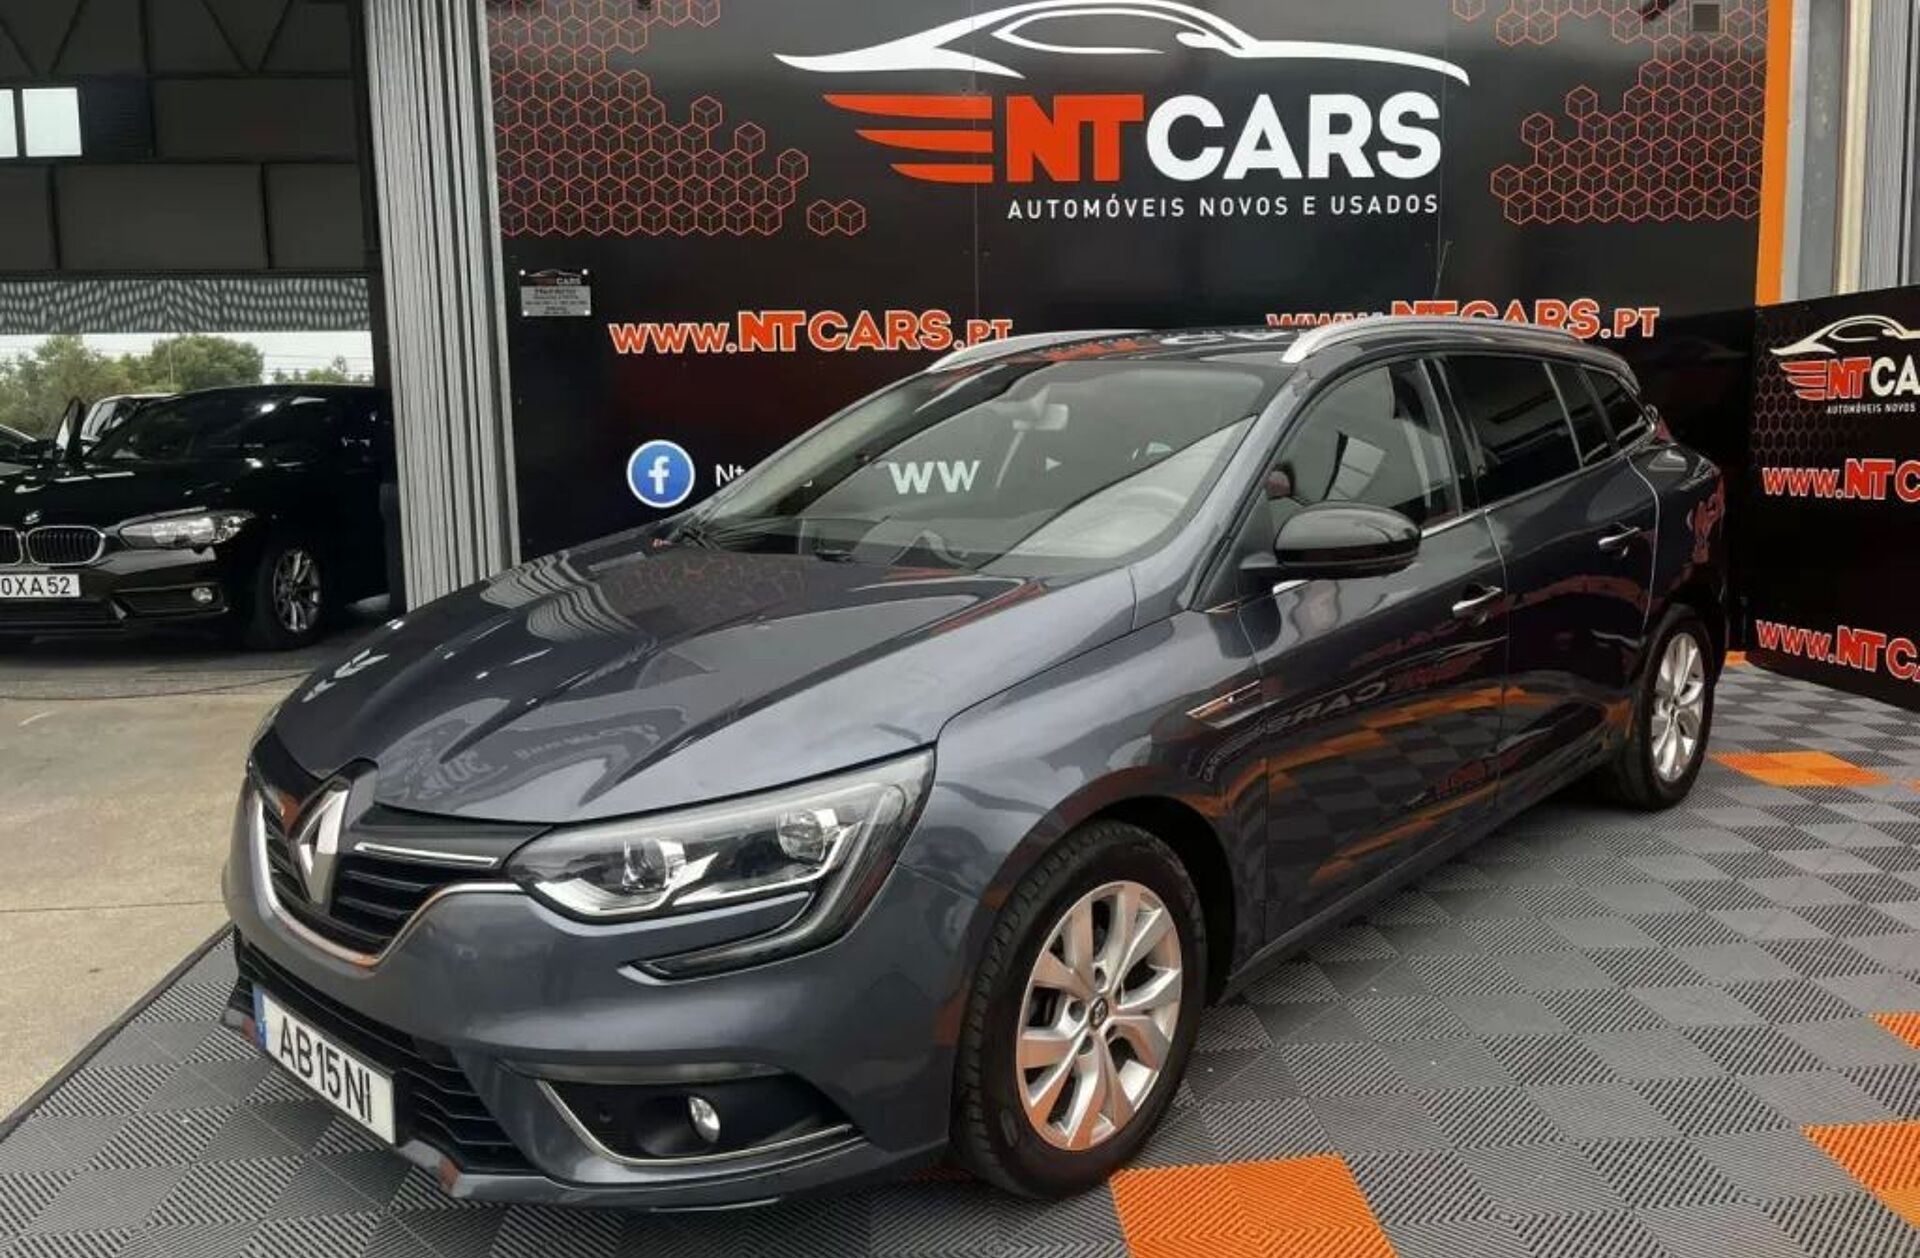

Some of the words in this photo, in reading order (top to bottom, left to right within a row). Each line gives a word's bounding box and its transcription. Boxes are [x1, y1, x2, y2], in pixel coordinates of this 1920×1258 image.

[1007, 91, 1441, 182] NTCARS
[1008, 194, 1184, 219] AUTOMÓVEIS
[1199, 195, 1288, 216] NOVOS
[1303, 196, 1316, 215] E
[1331, 194, 1439, 215] USADOS
[1885, 402, 1916, 412] NOVOS
[1755, 619, 1920, 682] www.NTC
[279, 1015, 372, 1123] AB15NI
